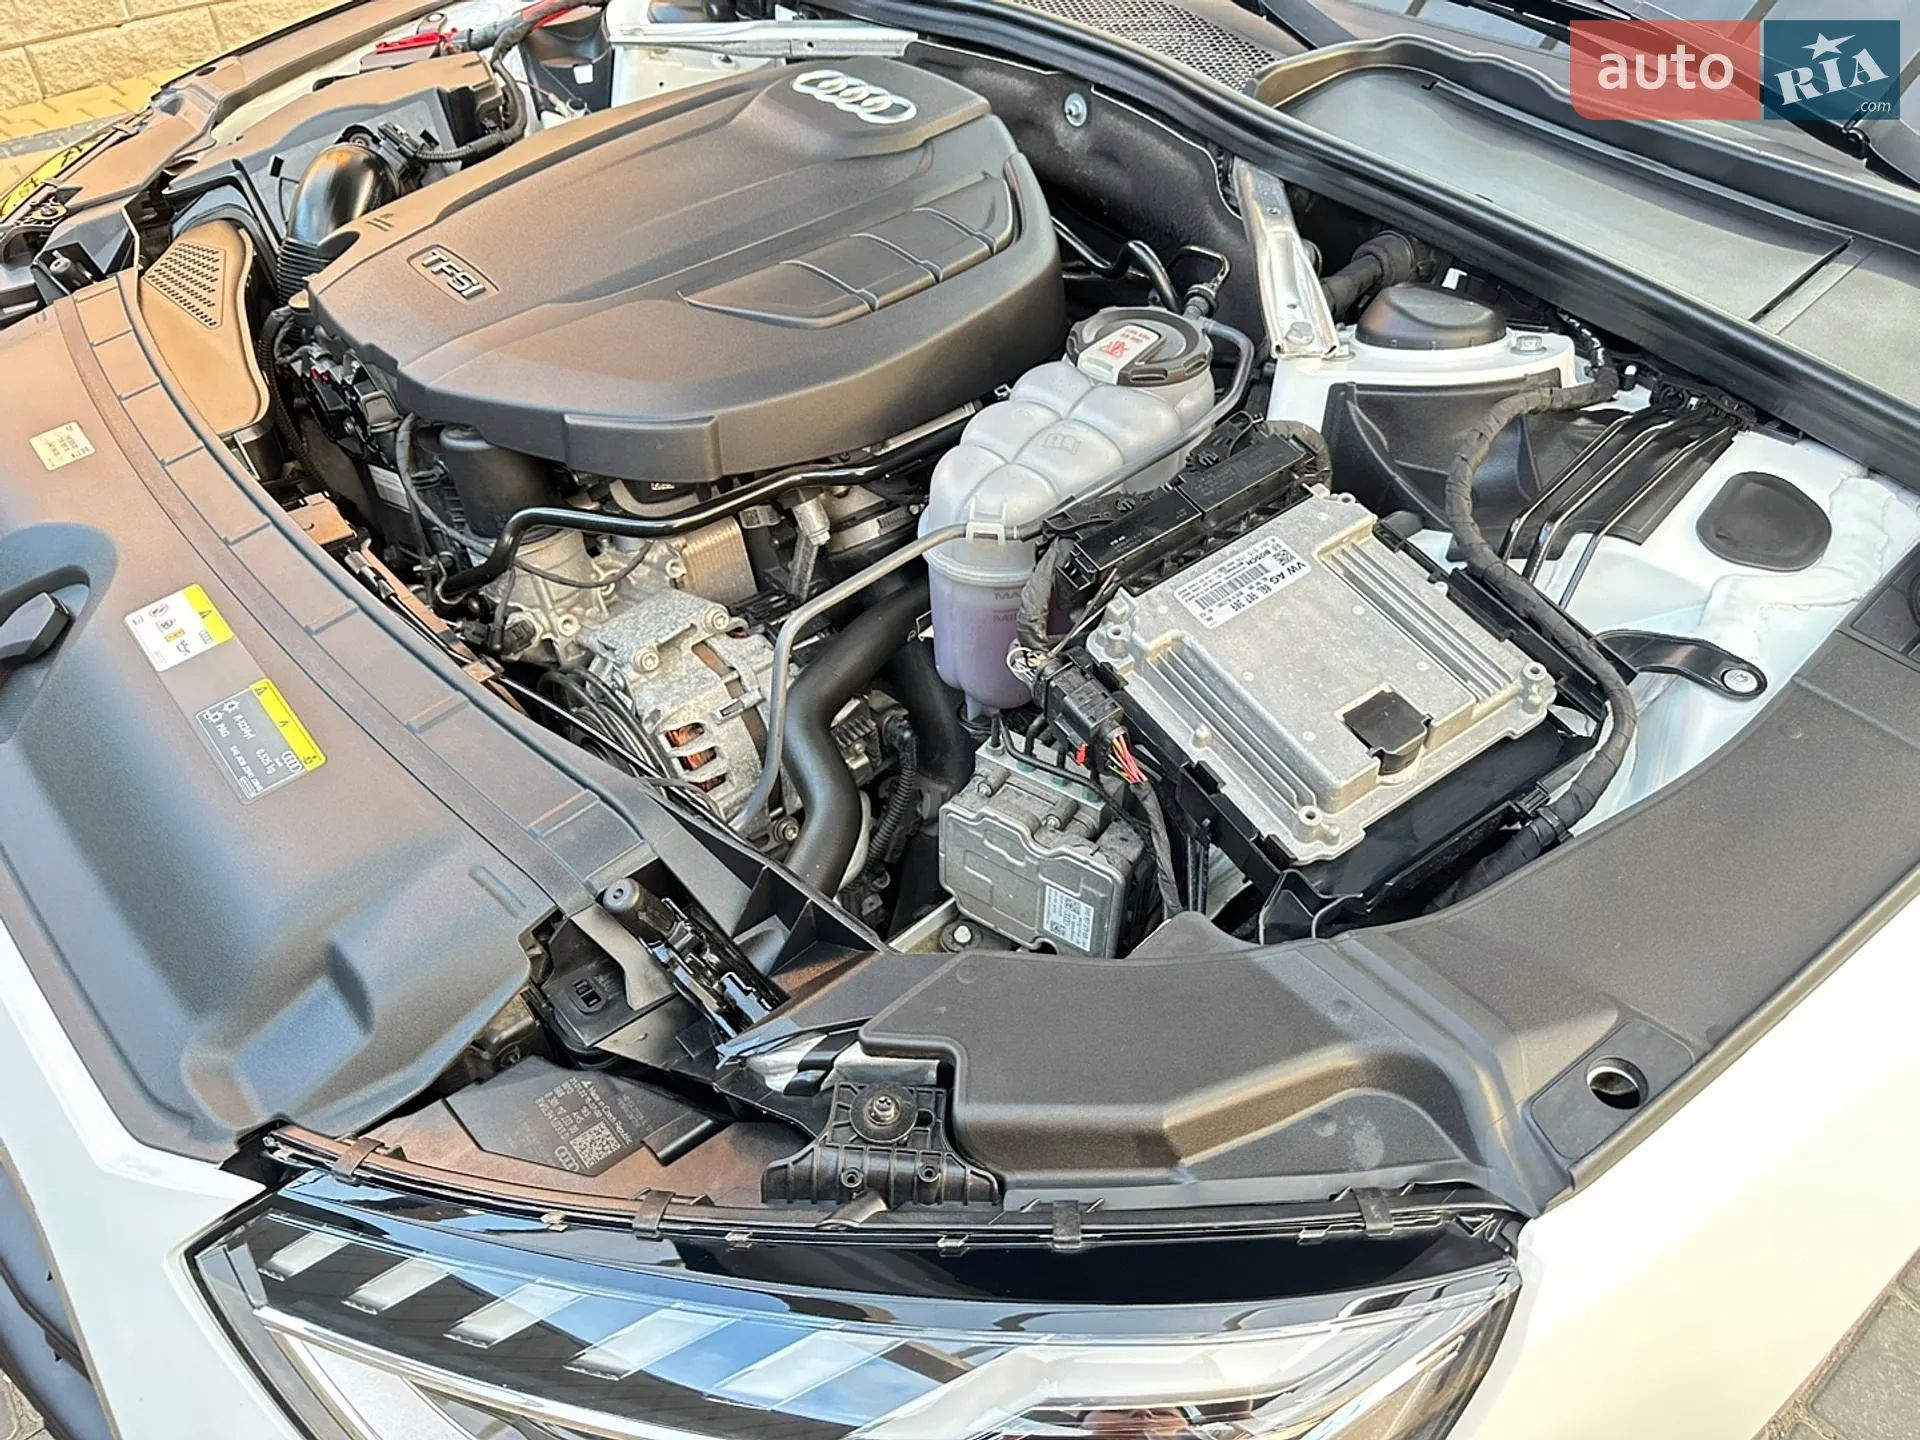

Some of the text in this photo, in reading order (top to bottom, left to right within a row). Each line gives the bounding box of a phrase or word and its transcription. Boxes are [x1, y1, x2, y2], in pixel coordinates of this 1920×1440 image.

[421, 249, 486, 300] TFSI
[1246, 549, 1272, 566] BOSCH
[1286, 561, 1306, 575] VW
[1269, 571, 1286, 585] AG
[995, 592, 1021, 600] MA
